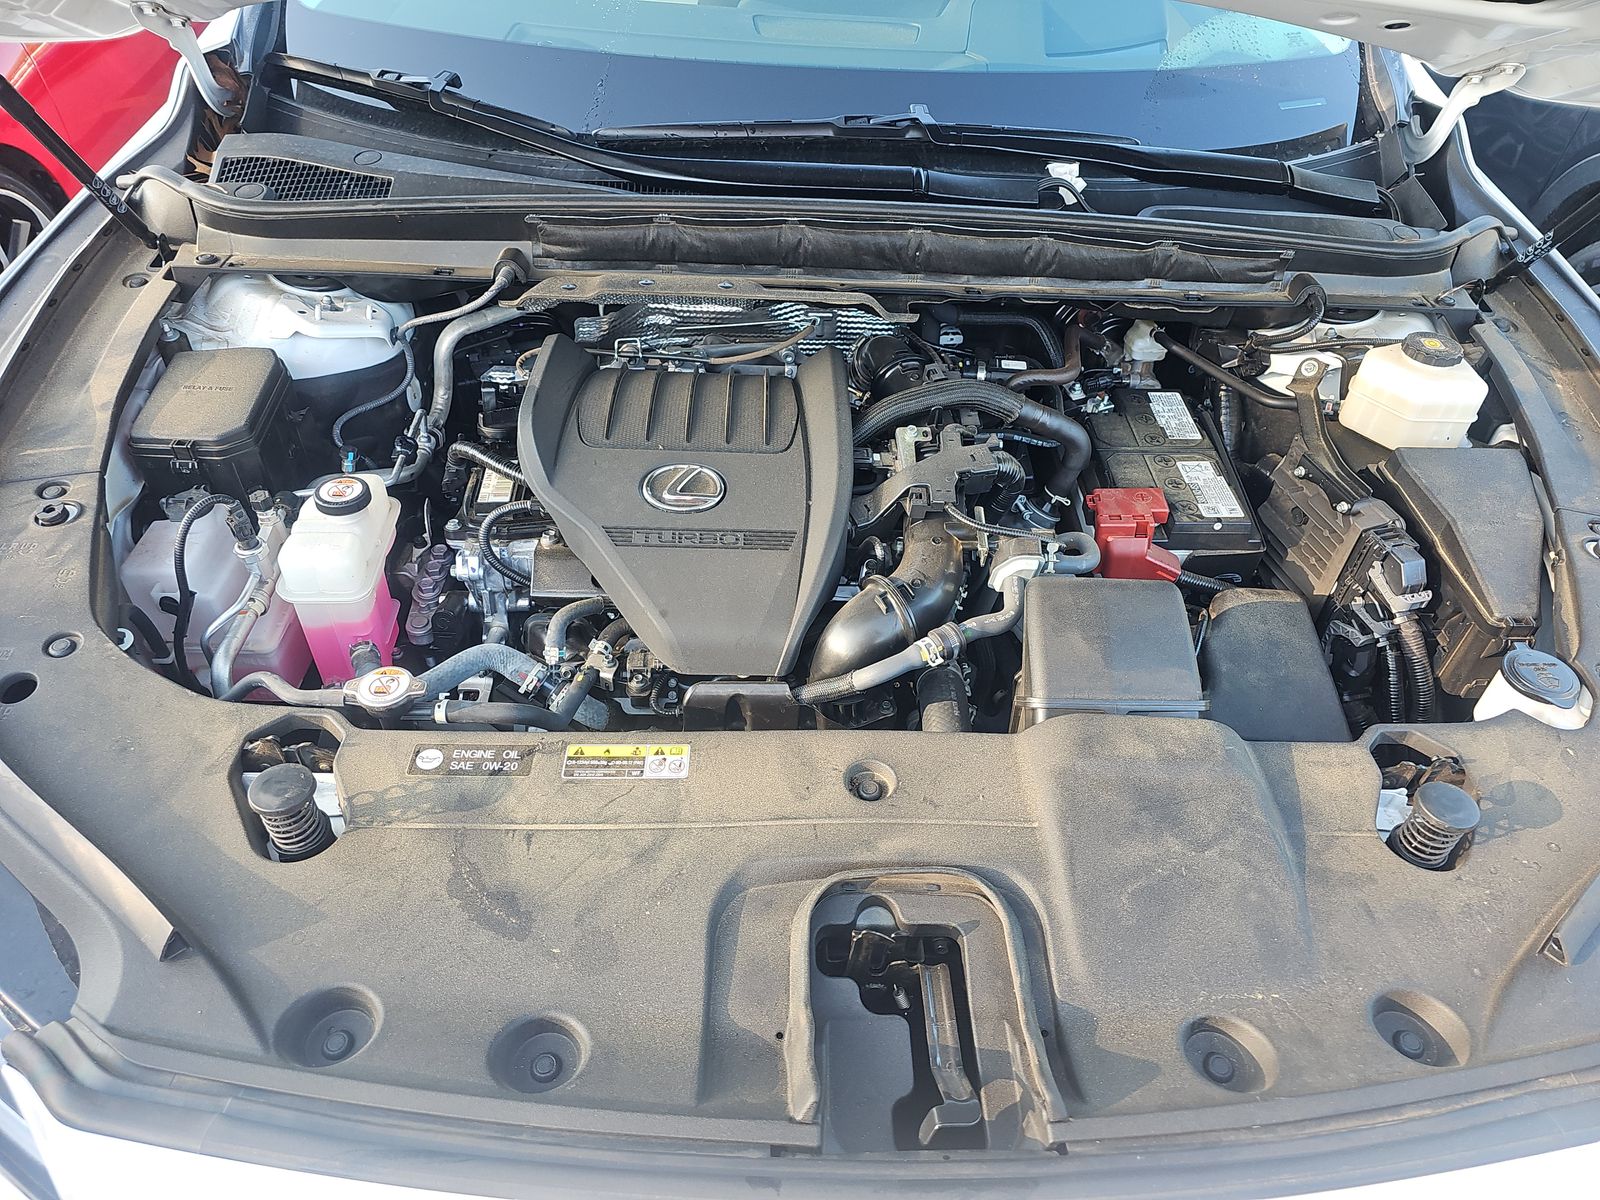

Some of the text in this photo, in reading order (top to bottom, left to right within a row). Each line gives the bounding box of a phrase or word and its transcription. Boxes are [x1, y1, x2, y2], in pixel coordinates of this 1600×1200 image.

[632, 530, 743, 545] TURBO
[453, 749, 522, 759] ENGINE OIL
[449, 761, 519, 771] SAE 0W-20
